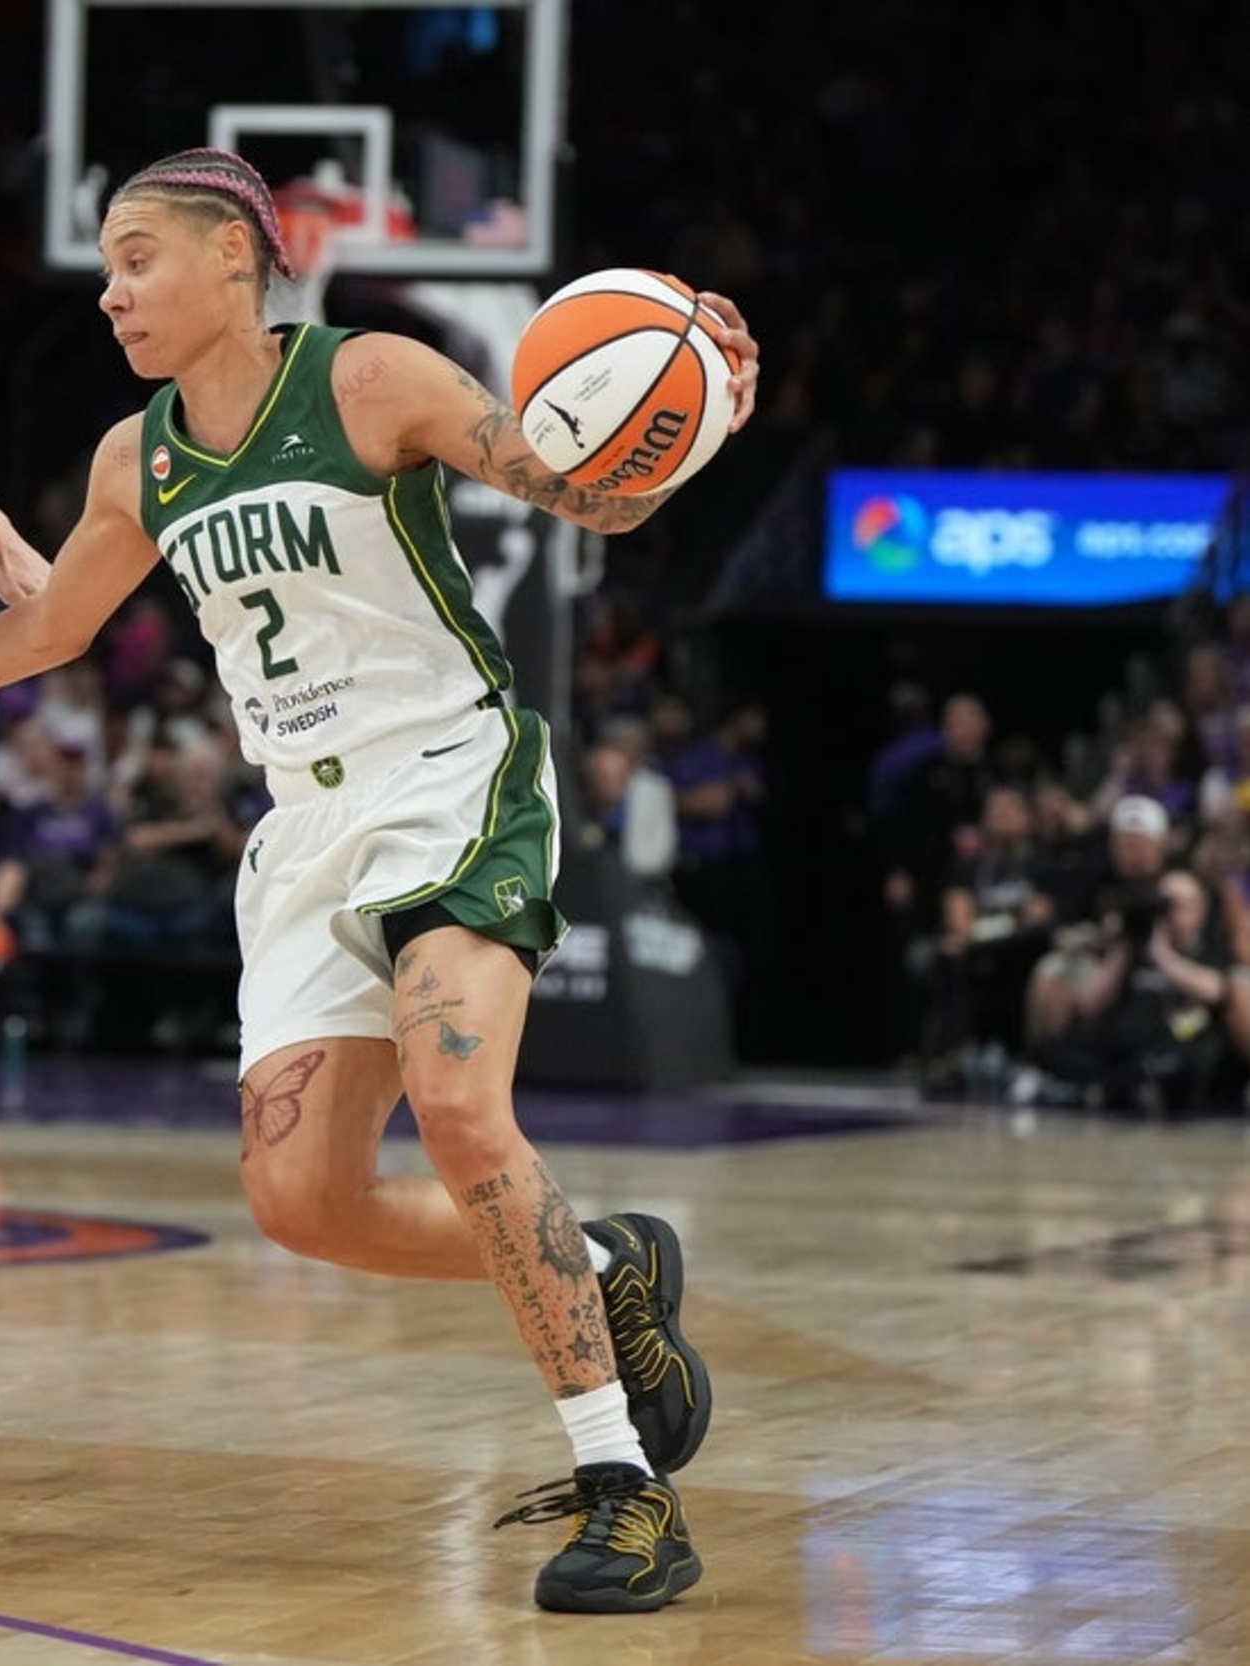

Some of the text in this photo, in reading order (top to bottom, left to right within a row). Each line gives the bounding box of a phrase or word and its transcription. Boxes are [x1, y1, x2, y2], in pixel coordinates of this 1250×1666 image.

[165, 500, 342, 613] STORM
[930, 507, 1055, 578] aps
[239, 588, 299, 680] 2
[272, 676, 355, 712] Providence
[276, 701, 338, 737] SWEDISH
